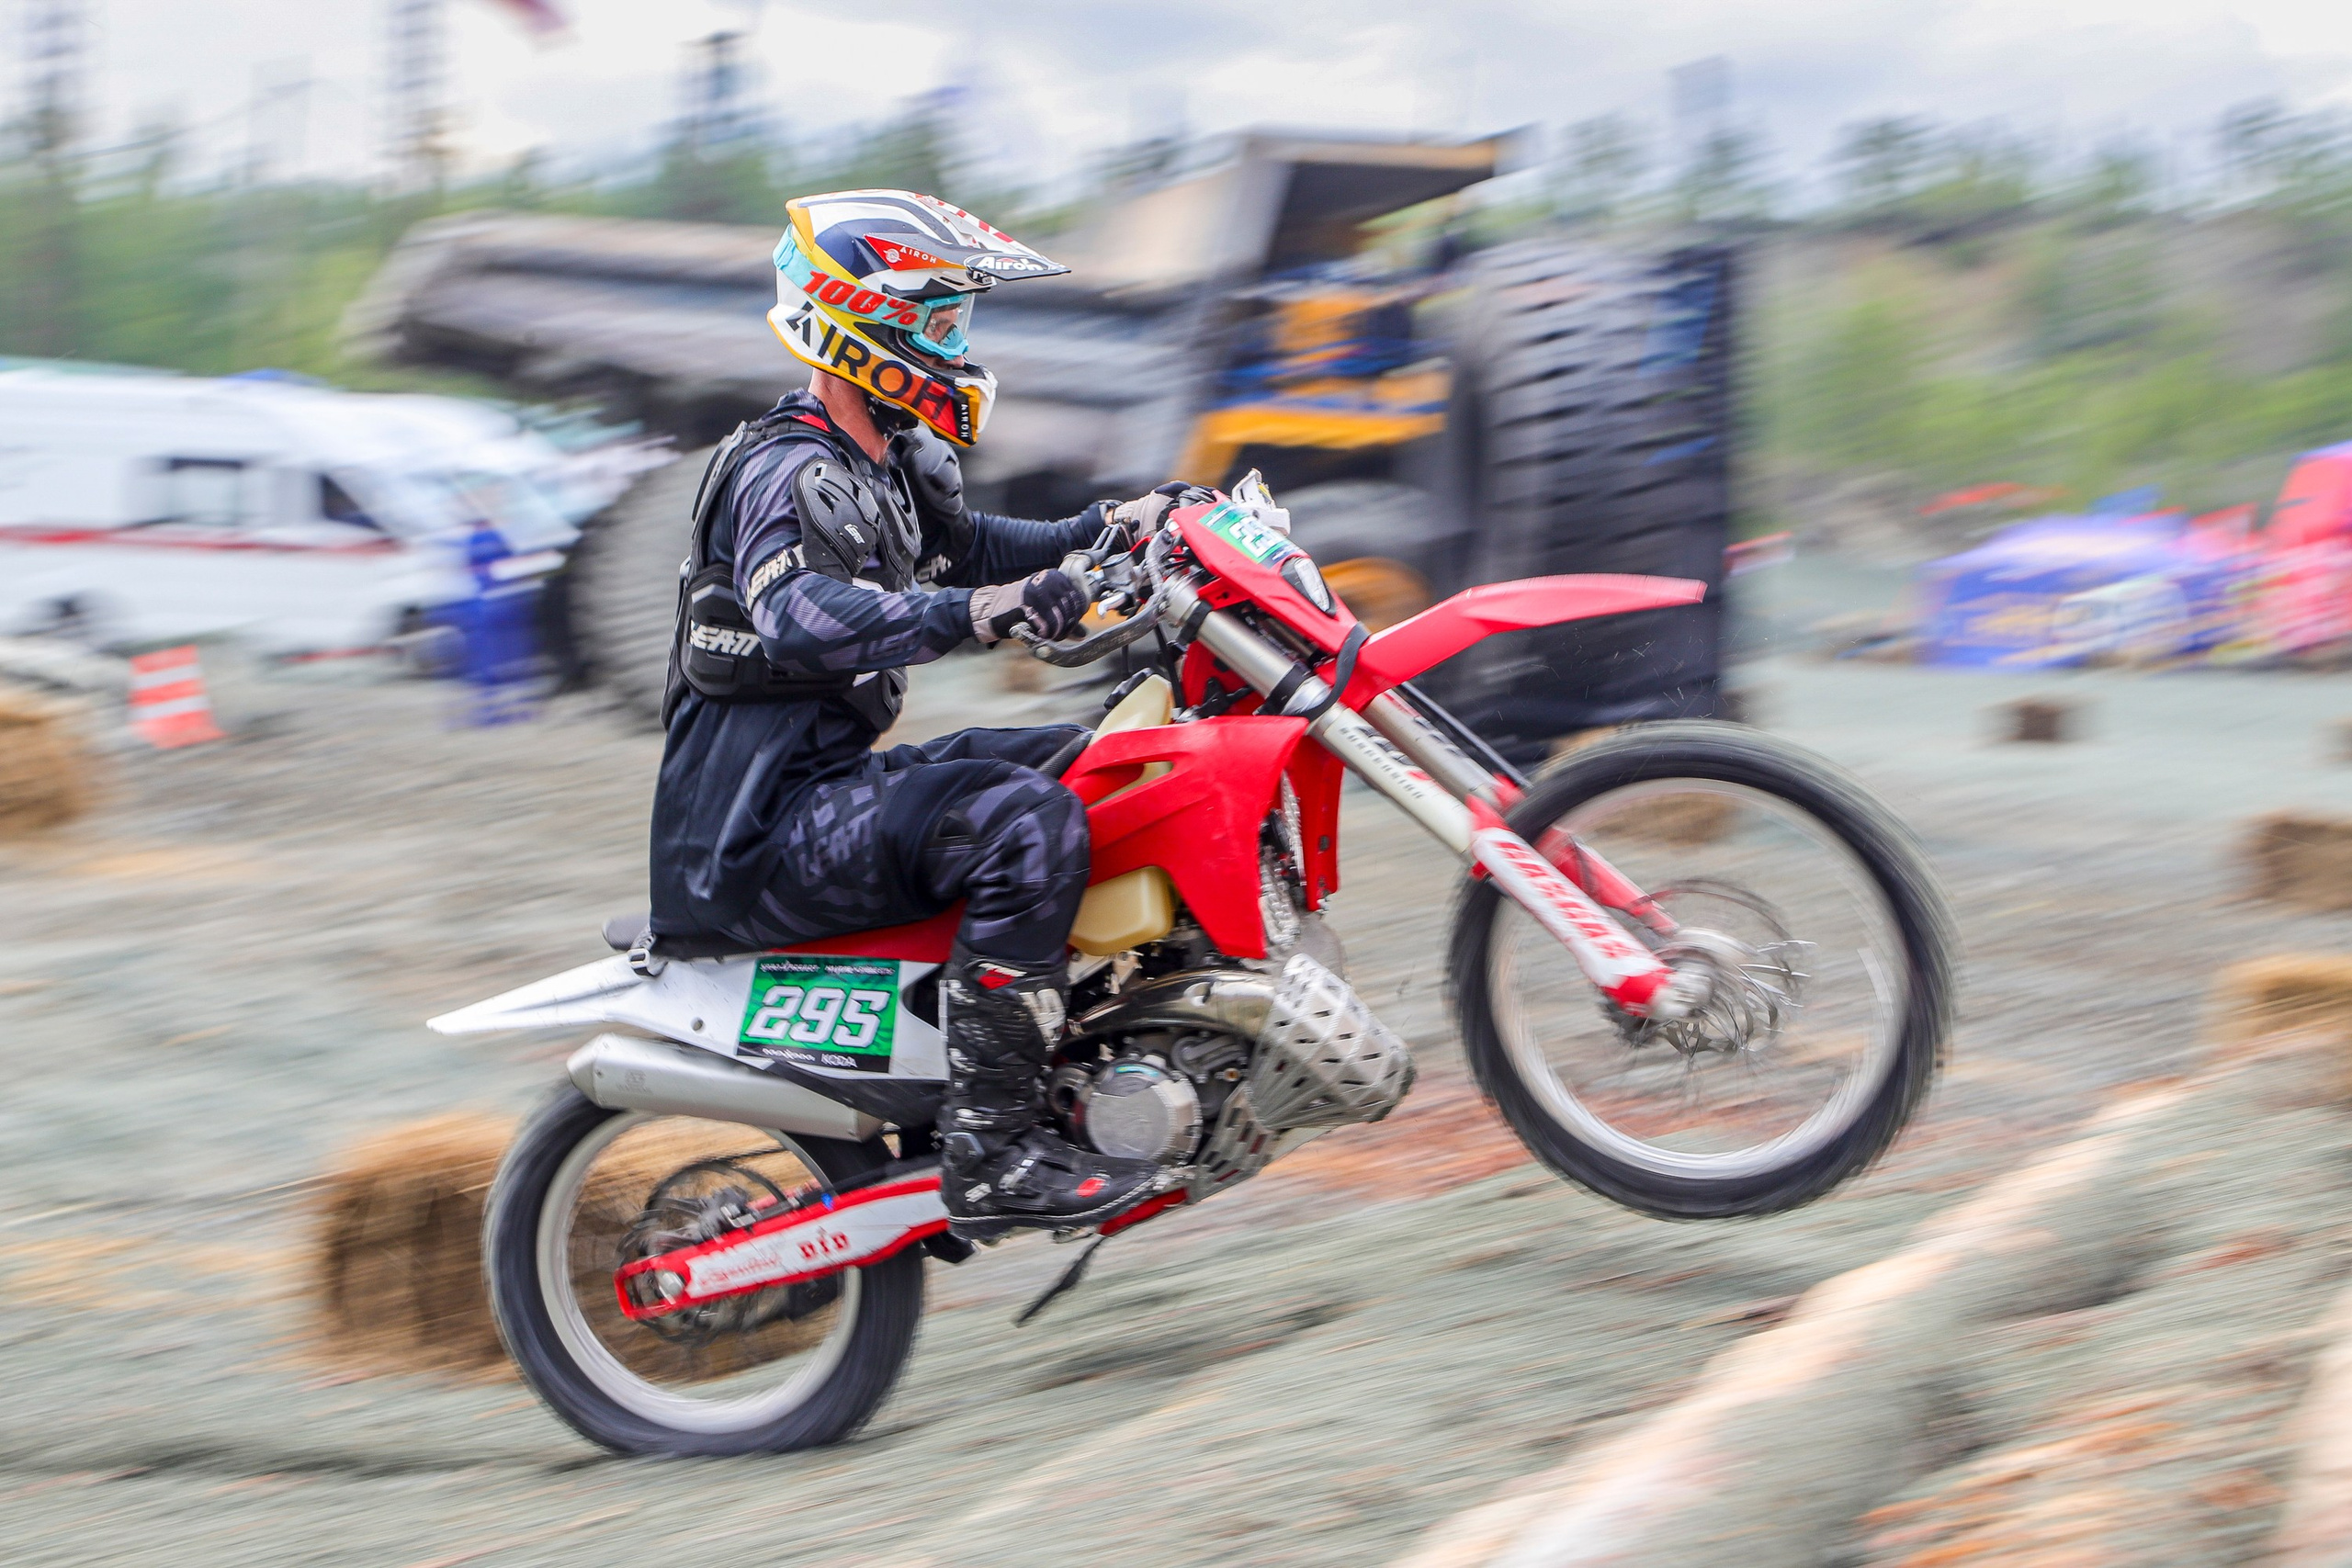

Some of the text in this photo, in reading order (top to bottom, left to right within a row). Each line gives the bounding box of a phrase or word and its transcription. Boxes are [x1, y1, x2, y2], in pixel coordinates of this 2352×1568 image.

[899, 246, 937, 265] AIROH
[976, 256, 1044, 271] Airoh
[802, 269, 919, 326] 100%
[786, 301, 957, 421] AIROH
[745, 985, 891, 1048] 295
